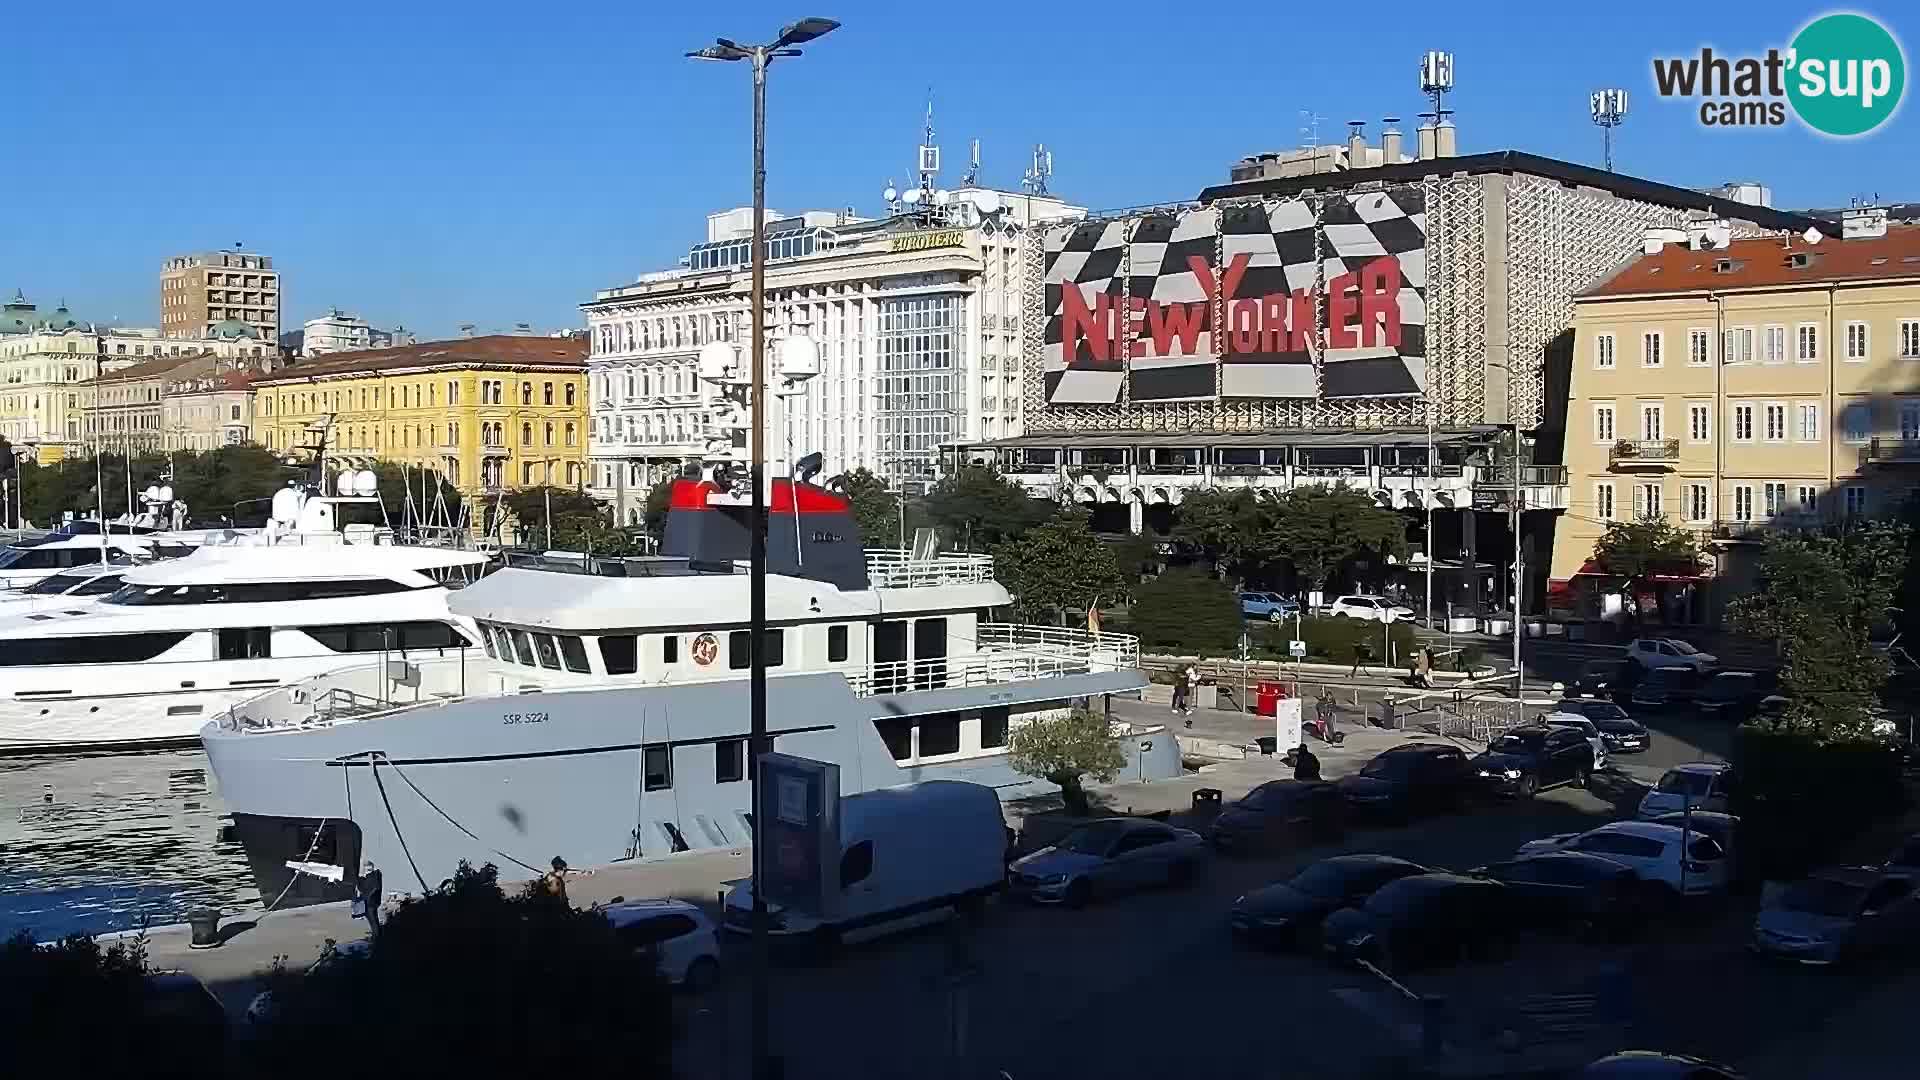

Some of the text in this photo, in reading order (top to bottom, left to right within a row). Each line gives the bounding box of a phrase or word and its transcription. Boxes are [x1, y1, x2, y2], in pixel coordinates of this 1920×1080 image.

[1062, 253, 1401, 362] NEW YORKER
[503, 712, 549, 725] SSR 5224
